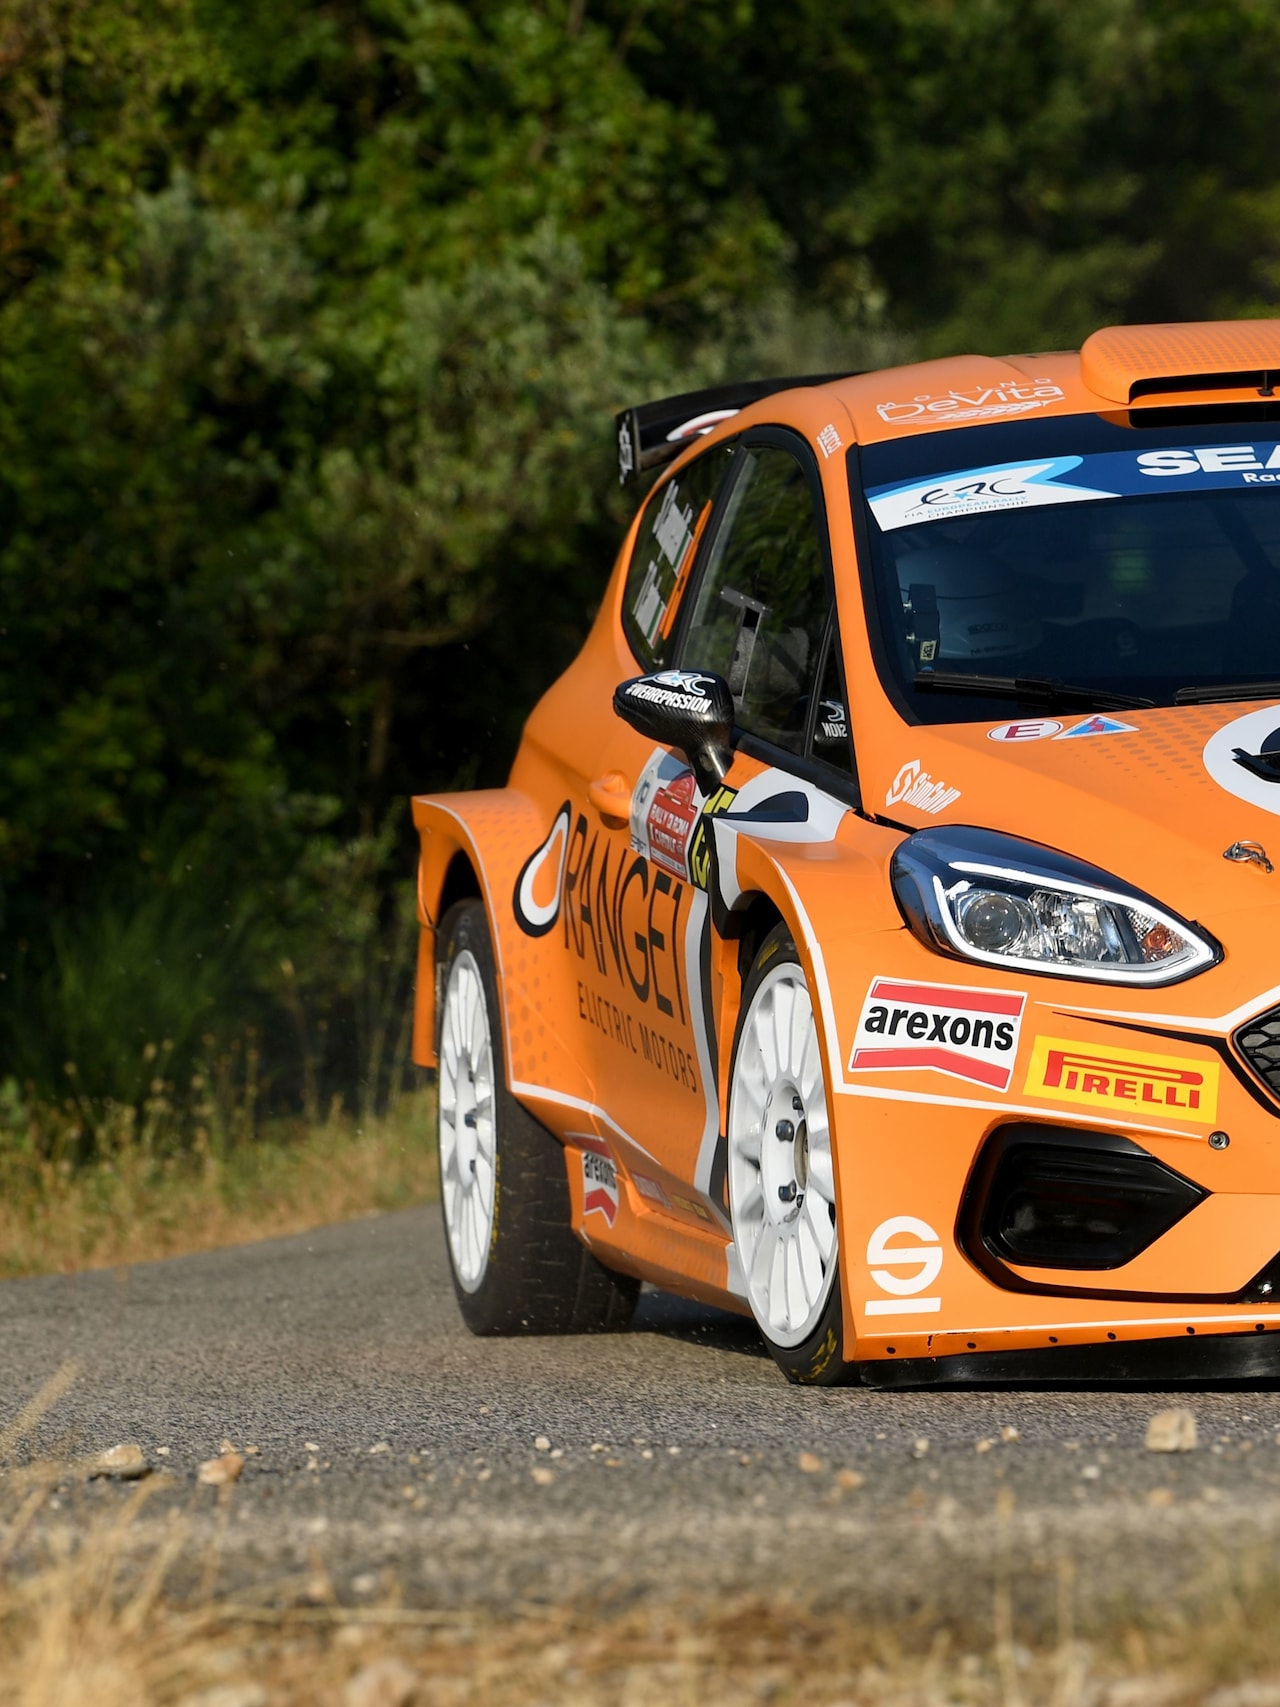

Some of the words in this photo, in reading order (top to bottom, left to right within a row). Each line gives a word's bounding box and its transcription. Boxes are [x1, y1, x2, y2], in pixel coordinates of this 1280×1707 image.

[878, 385, 1064, 422] DeVita
[511, 799, 687, 1027] ORANGE1
[638, 1022, 697, 1093] MOTORS
[865, 1006, 1014, 1051] arexons
[1042, 1050, 1204, 1109] PIRELLI
